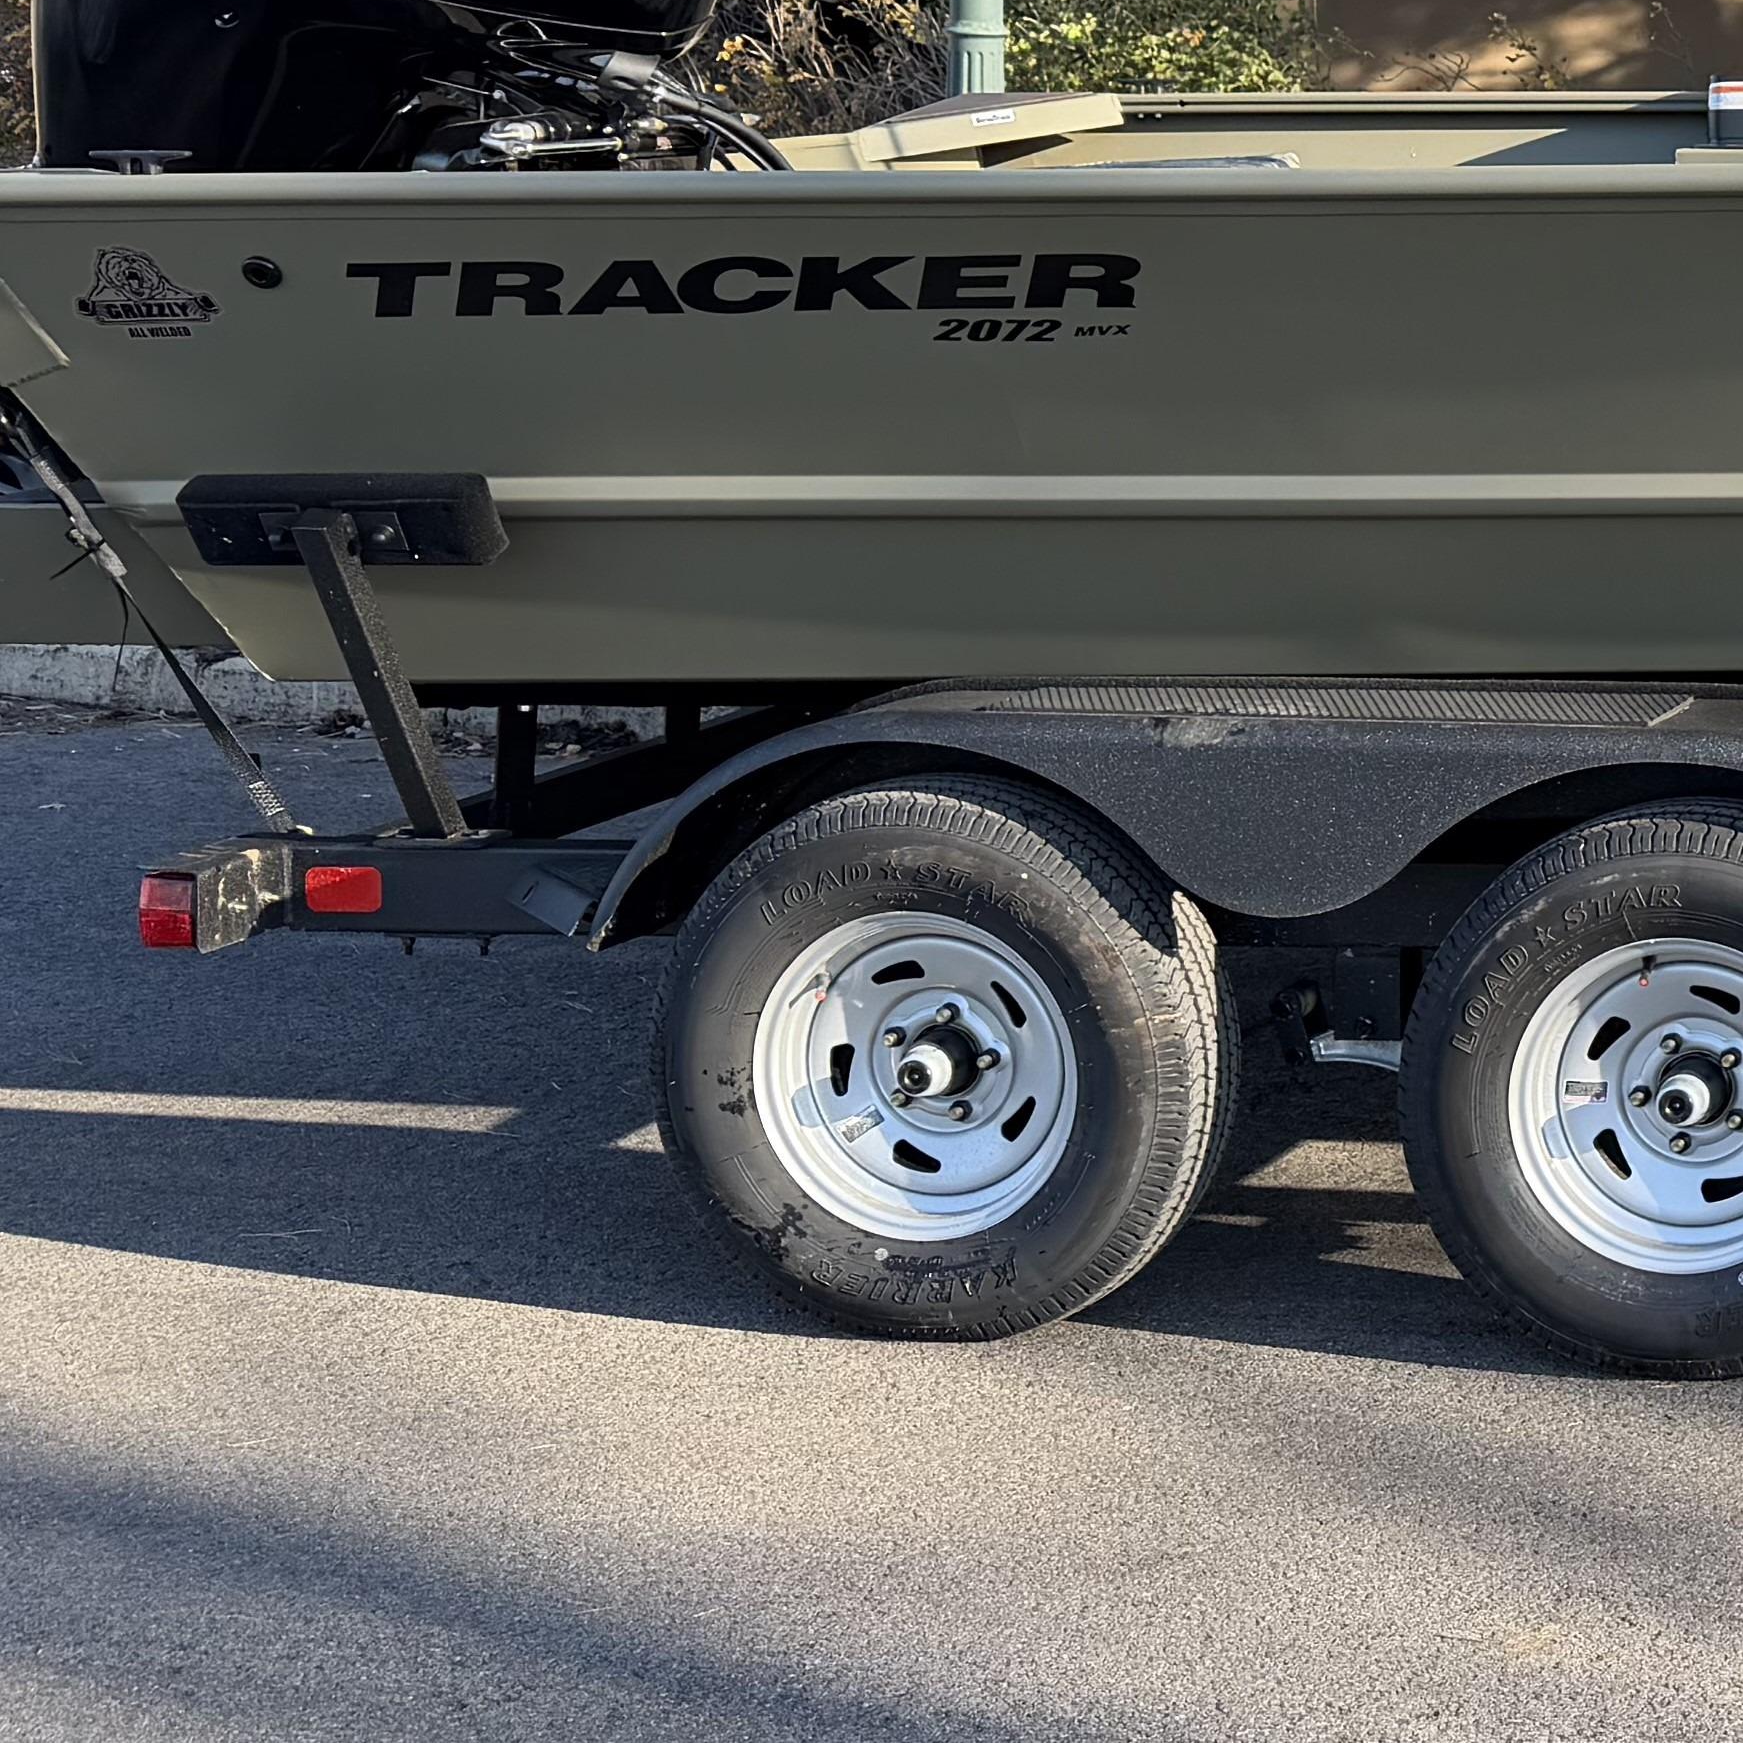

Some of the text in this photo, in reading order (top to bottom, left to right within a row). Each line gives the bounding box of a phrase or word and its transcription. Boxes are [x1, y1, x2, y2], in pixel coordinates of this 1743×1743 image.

[107, 302, 190, 319] GRIZZLY
[346, 254, 1142, 318] TRACKER
[128, 327, 148, 338] ALL
[933, 319, 1131, 342] 2072 MVX
[759, 861, 1035, 928] LOAD STAR
[1451, 884, 1683, 1055] LOAD STAR
[811, 1247, 1018, 1306] KARRIER
